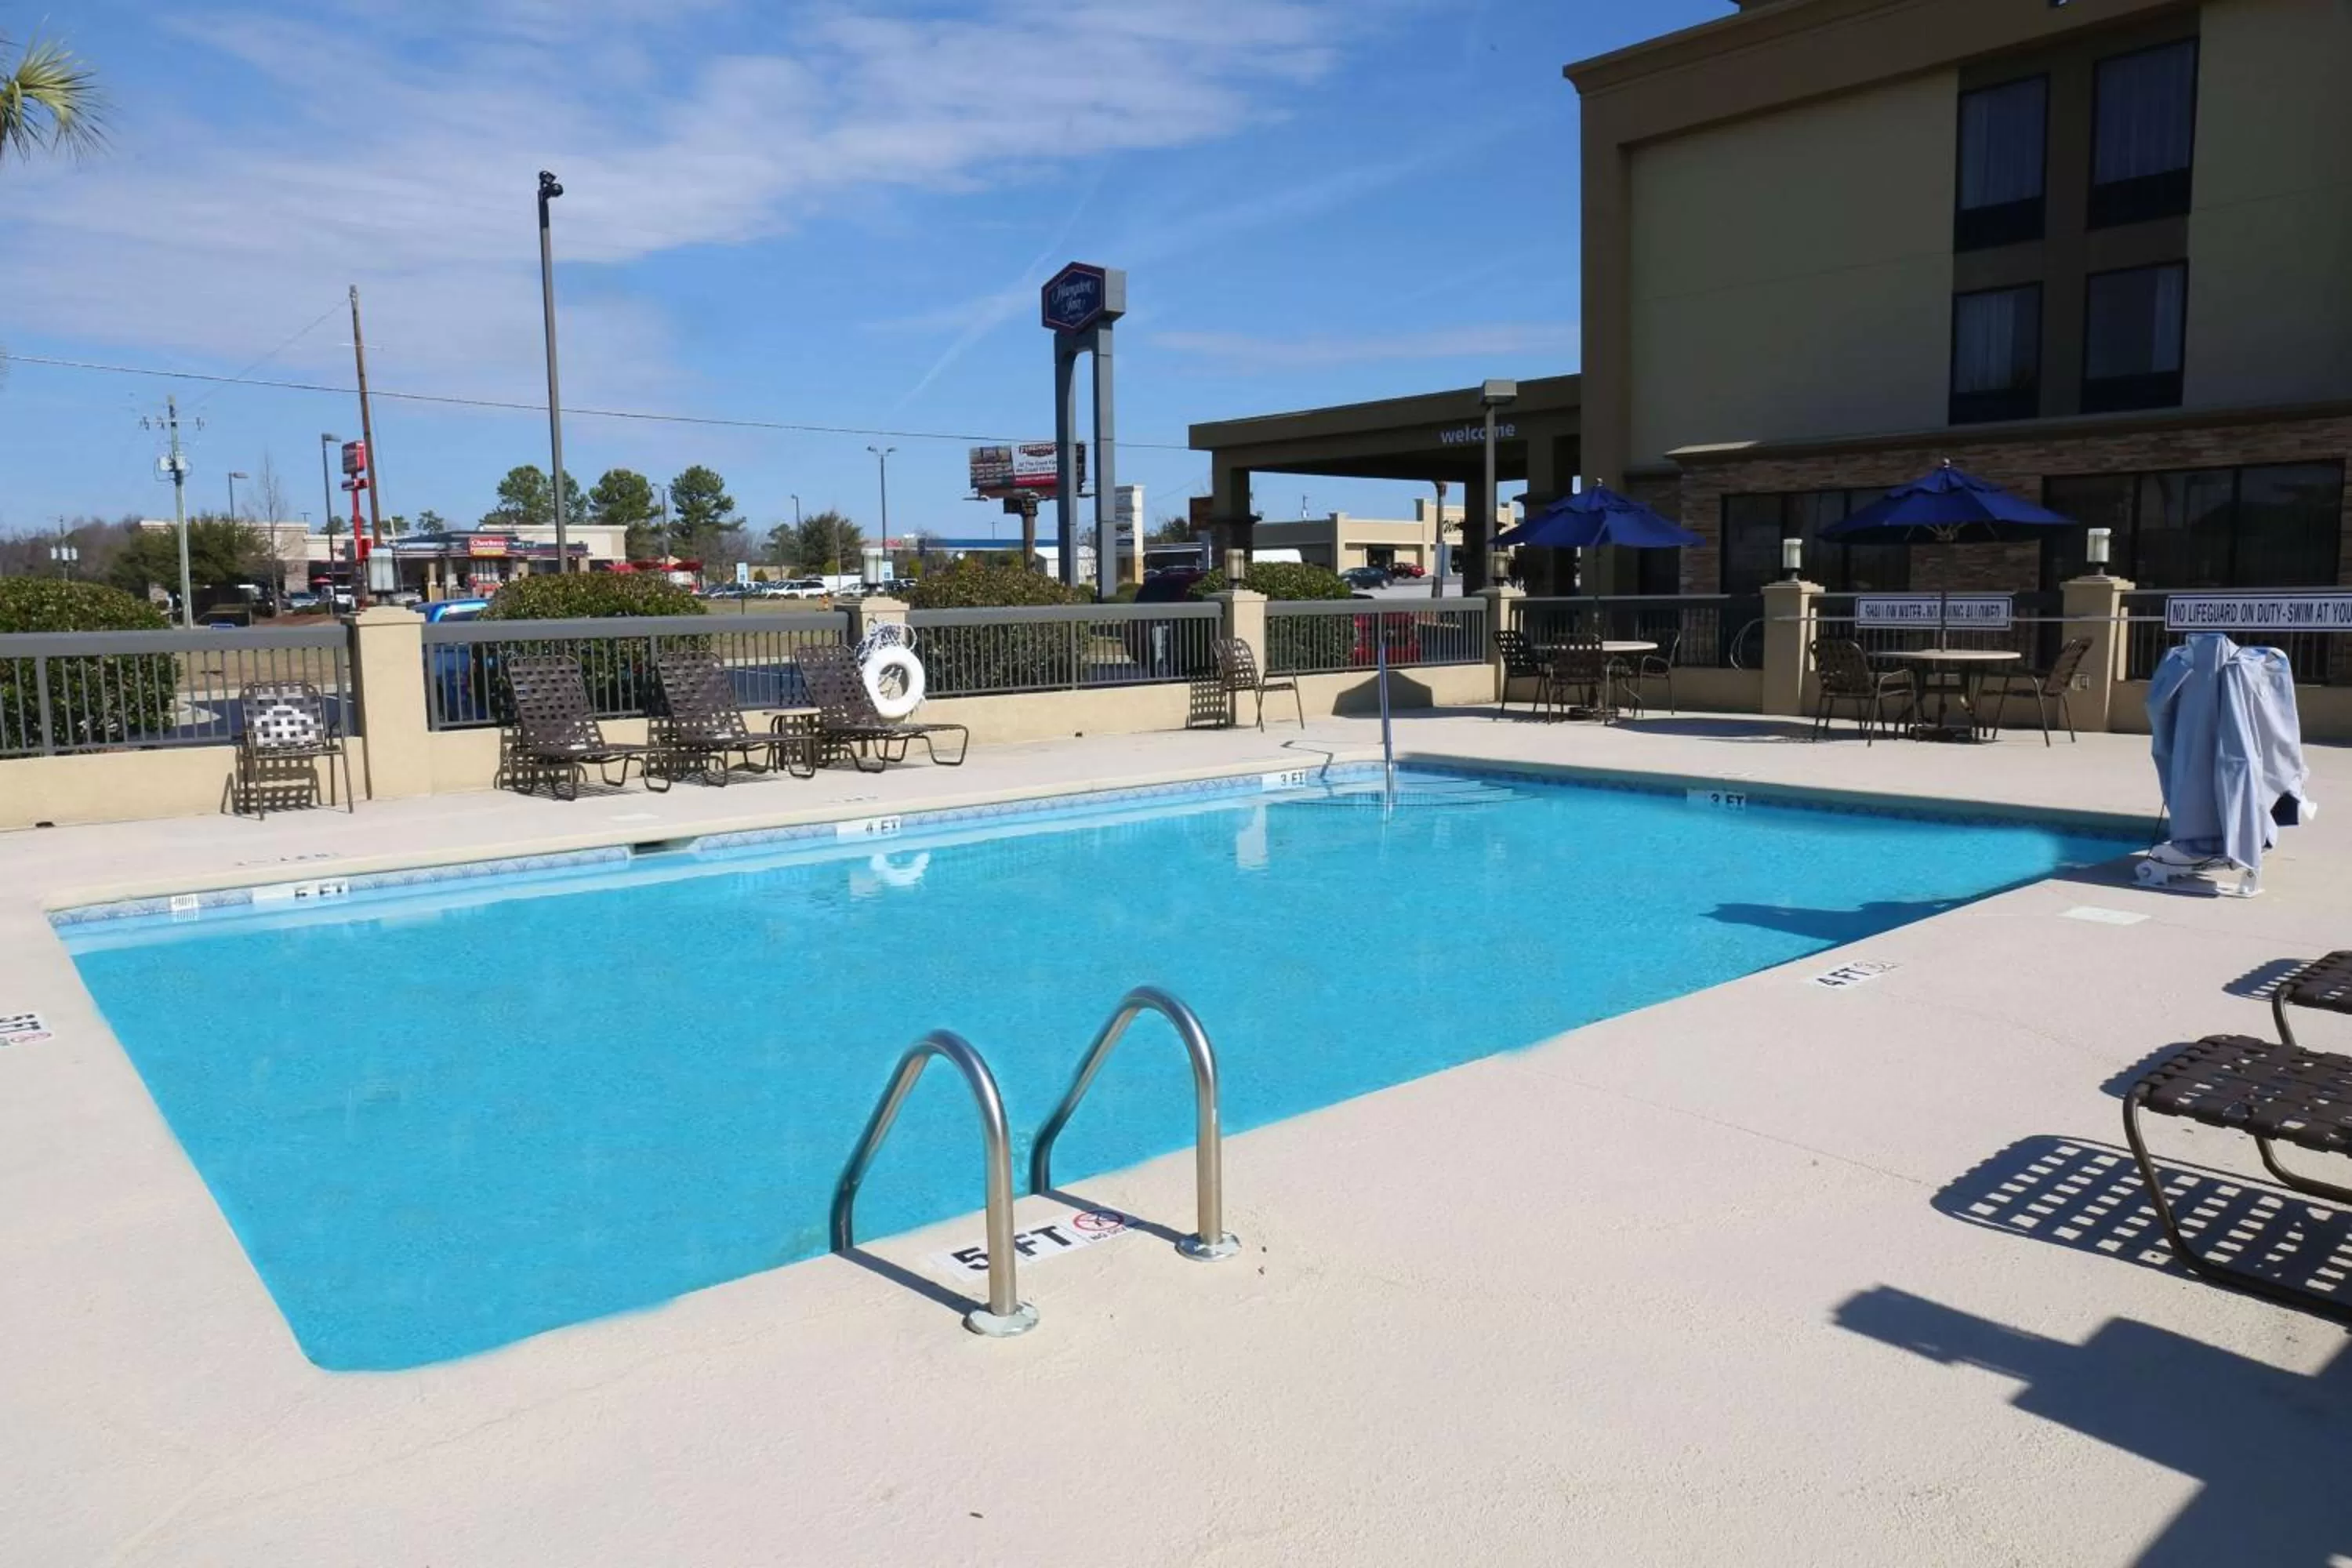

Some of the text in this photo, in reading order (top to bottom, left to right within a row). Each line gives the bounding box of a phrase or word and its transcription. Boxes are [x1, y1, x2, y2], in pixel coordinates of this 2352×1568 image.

[2172, 604, 2185, 622] NO
[2188, 603, 2237, 622] LIFEGUARD
[2241, 603, 2254, 622] ON
[2317, 604, 2328, 622] AT
[951, 1225, 1073, 1271] 5 FT
